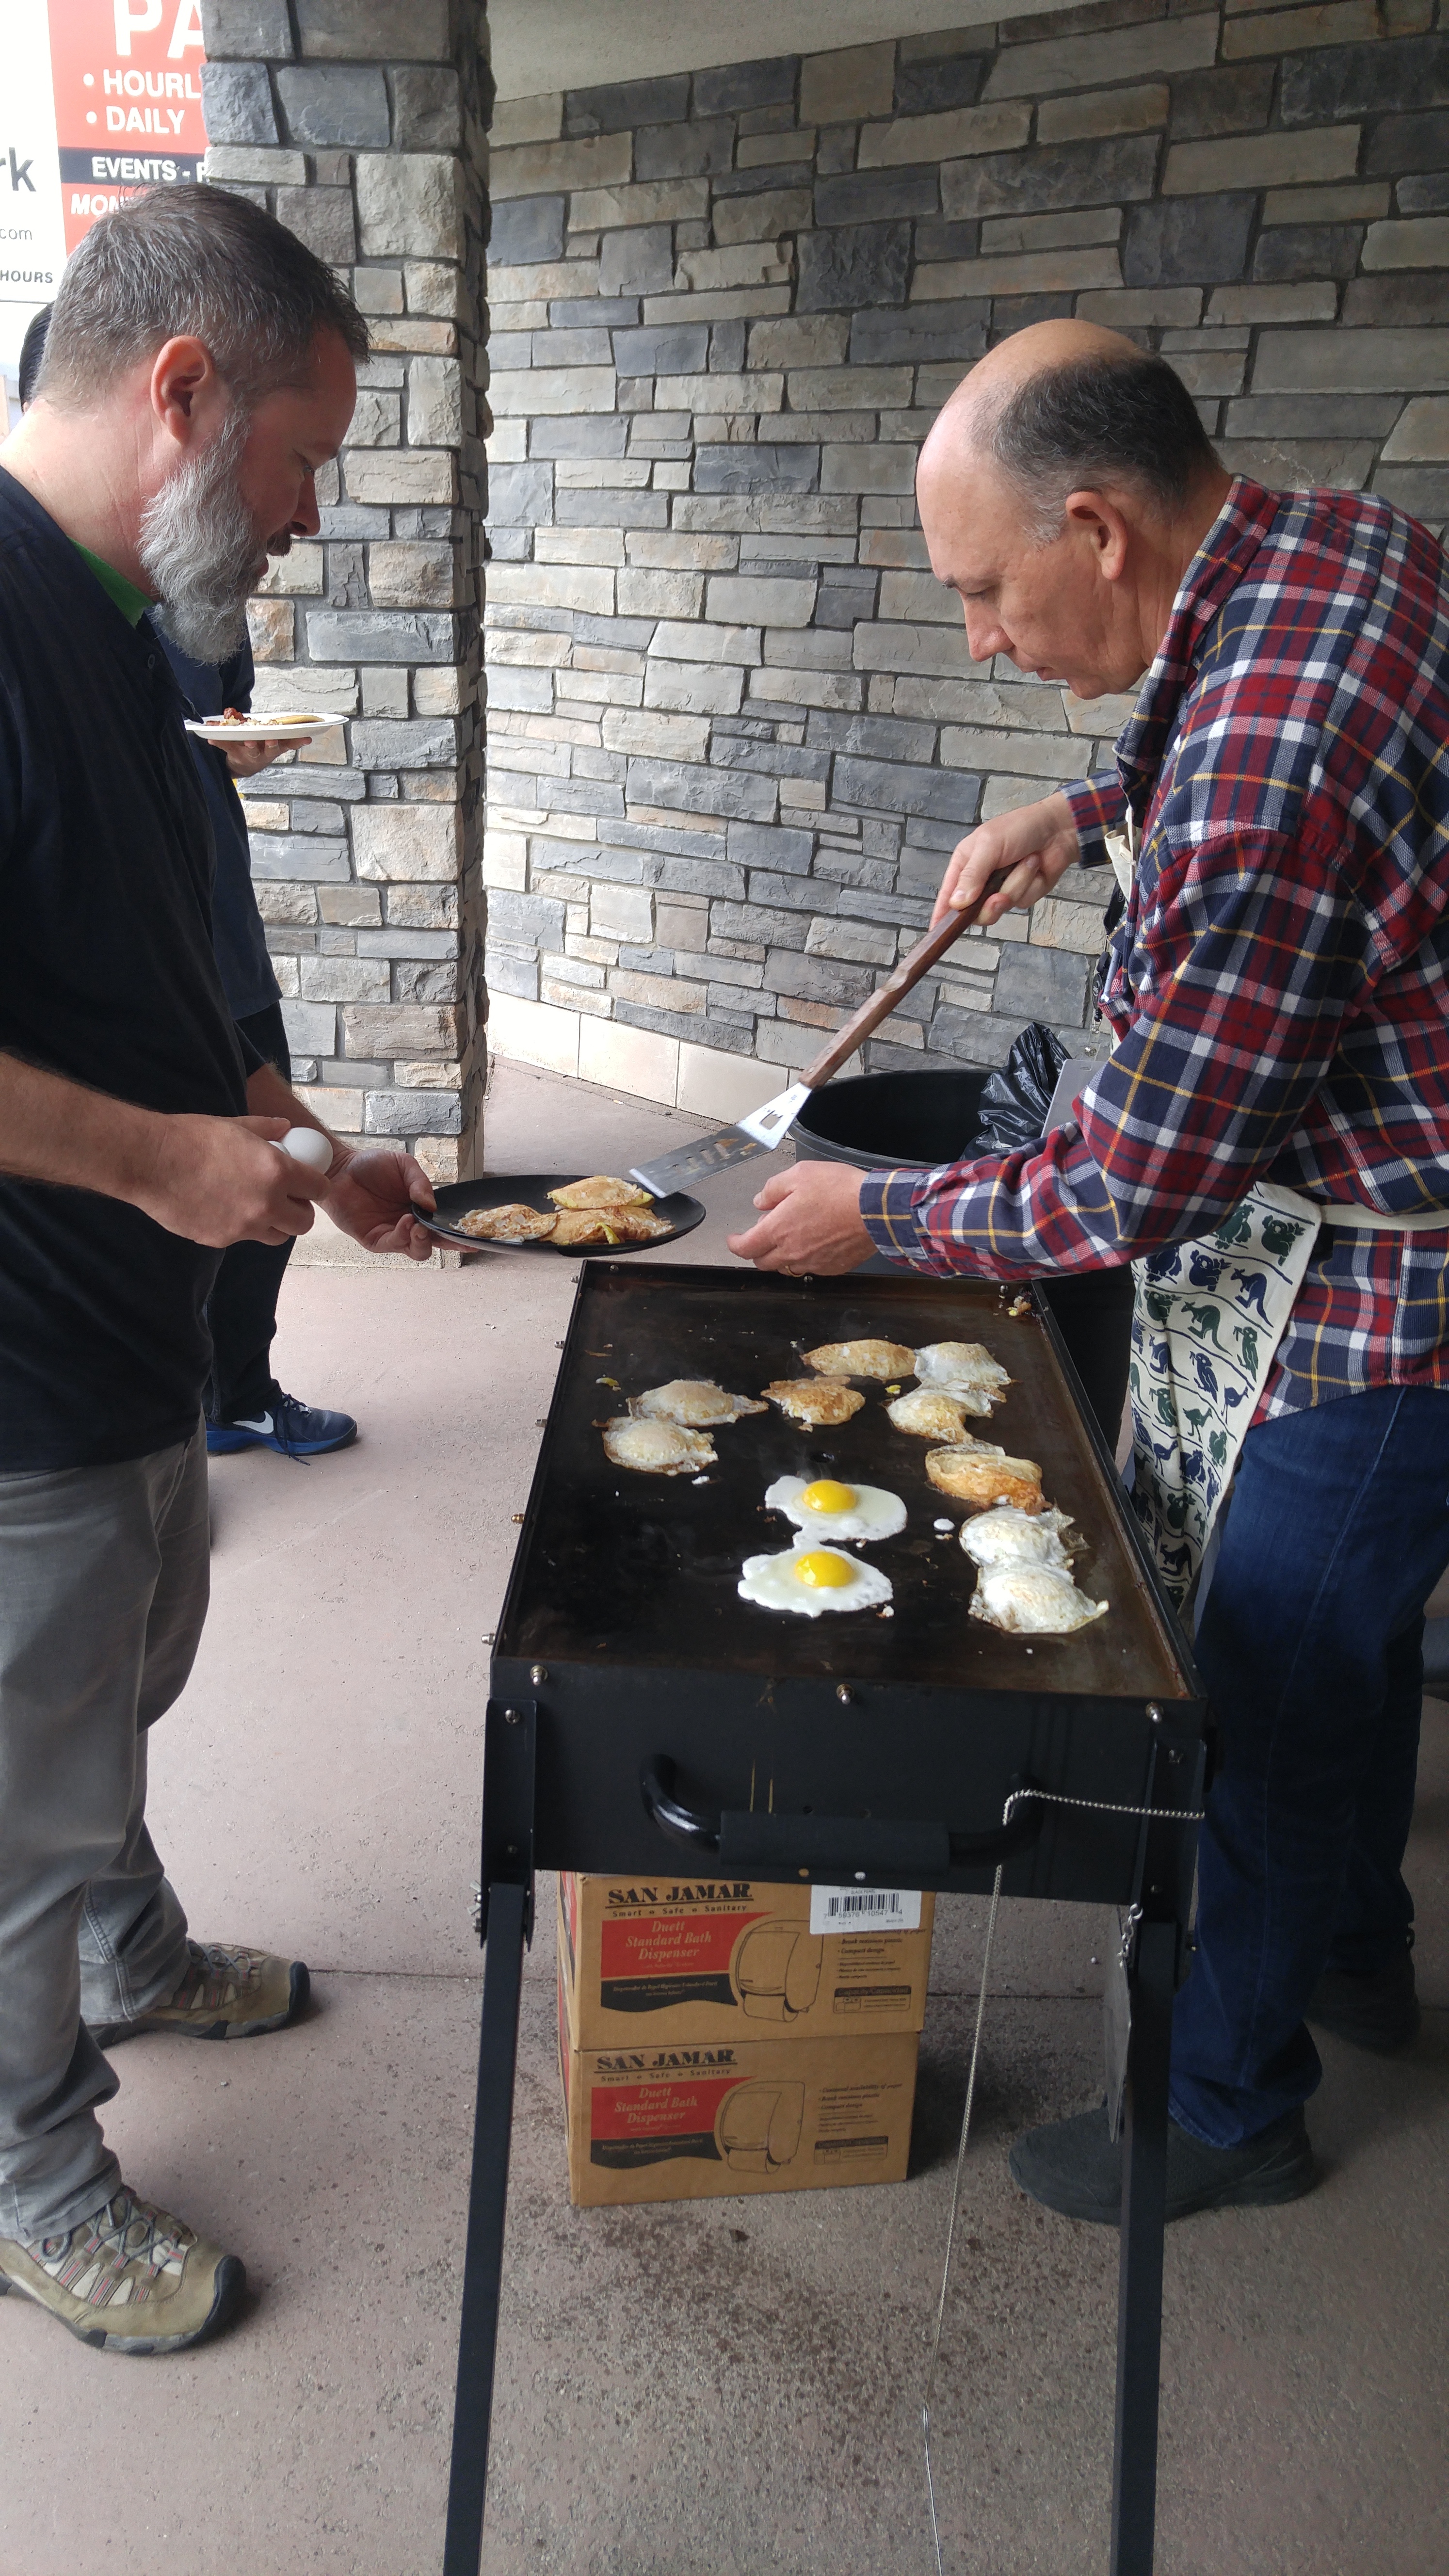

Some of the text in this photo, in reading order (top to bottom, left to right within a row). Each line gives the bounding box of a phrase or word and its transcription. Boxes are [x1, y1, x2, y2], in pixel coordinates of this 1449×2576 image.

[103, 69, 201, 99] HOURL
[106, 106, 185, 134] DAILY
[91, 156, 177, 181] EVENTS
[0, 270, 53, 284] HOURS
[608, 1883, 752, 1904] SAN JAMAR
[652, 1921, 685, 1933] Duett
[626, 1931, 712, 1948] Standard Bath
[638, 1948, 700, 1963] Dispenser
[596, 2049, 735, 2070] SAN JAMAR
[639, 2087, 672, 2099] Duett
[614, 2096, 697, 2113] Standard Bath
[627, 2111, 685, 2125] Dispenser
